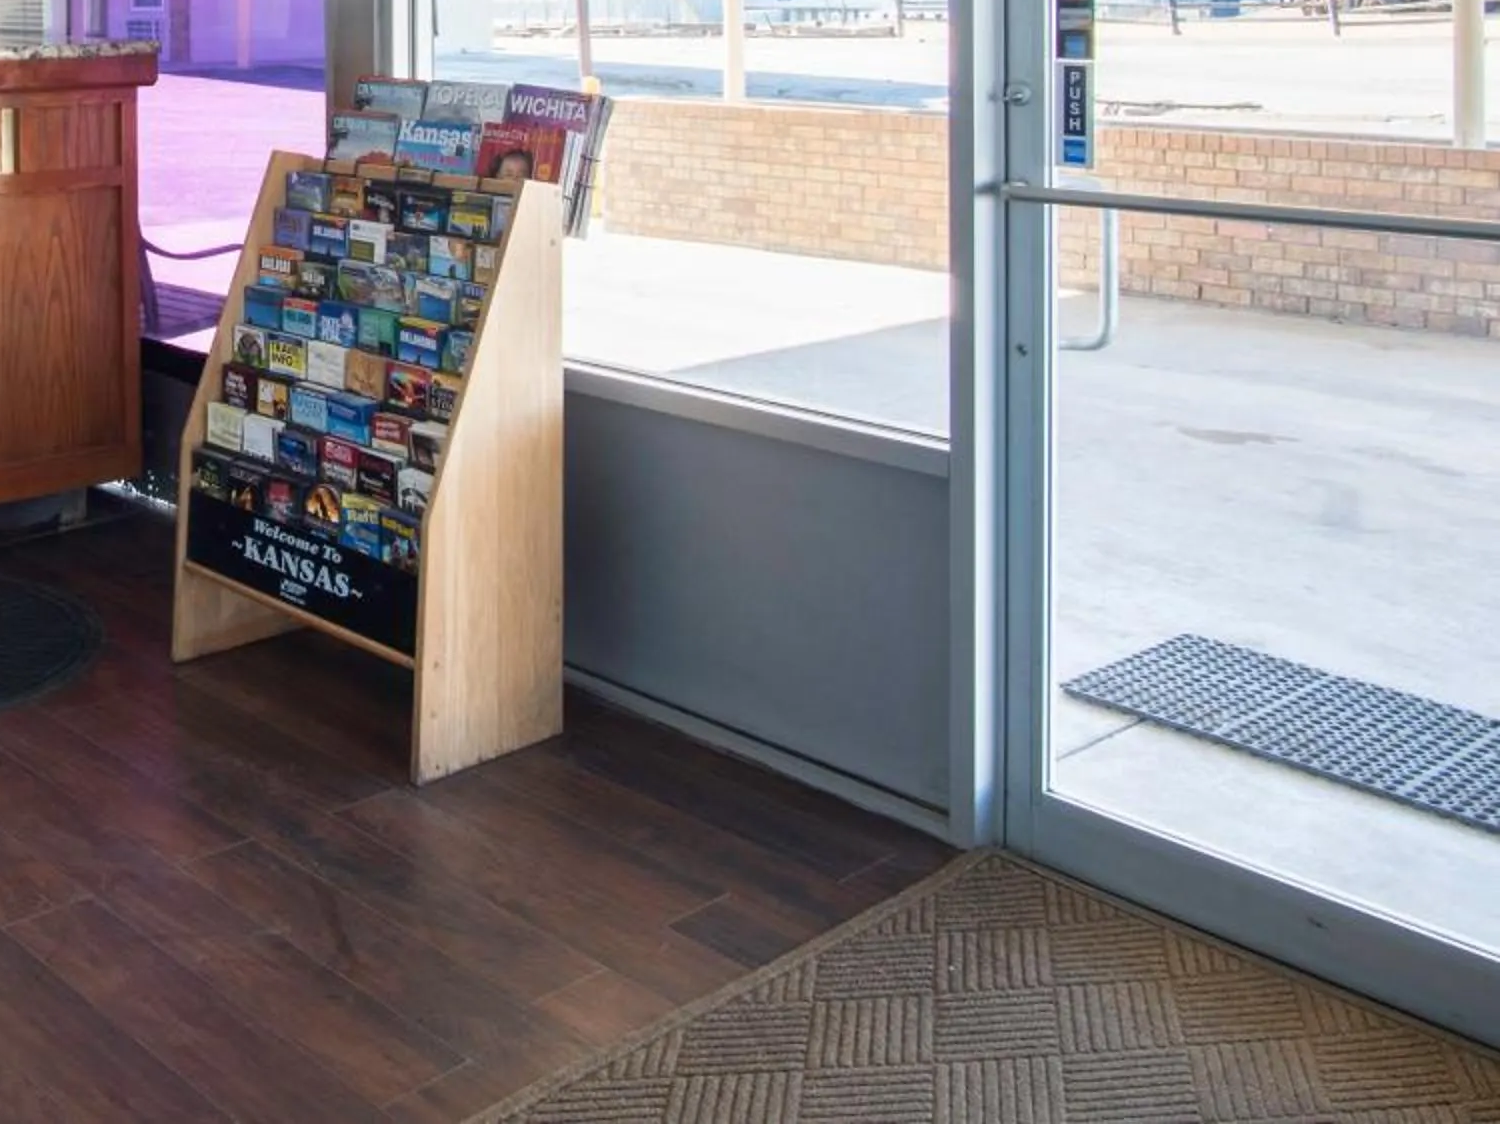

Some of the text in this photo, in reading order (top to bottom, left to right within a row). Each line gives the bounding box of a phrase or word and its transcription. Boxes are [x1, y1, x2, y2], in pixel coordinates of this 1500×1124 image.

[510, 93, 587, 121] WICHITA
[1069, 71, 1082, 131] PUSH
[397, 119, 471, 146] Kansas
[253, 519, 342, 564] Welcome To
